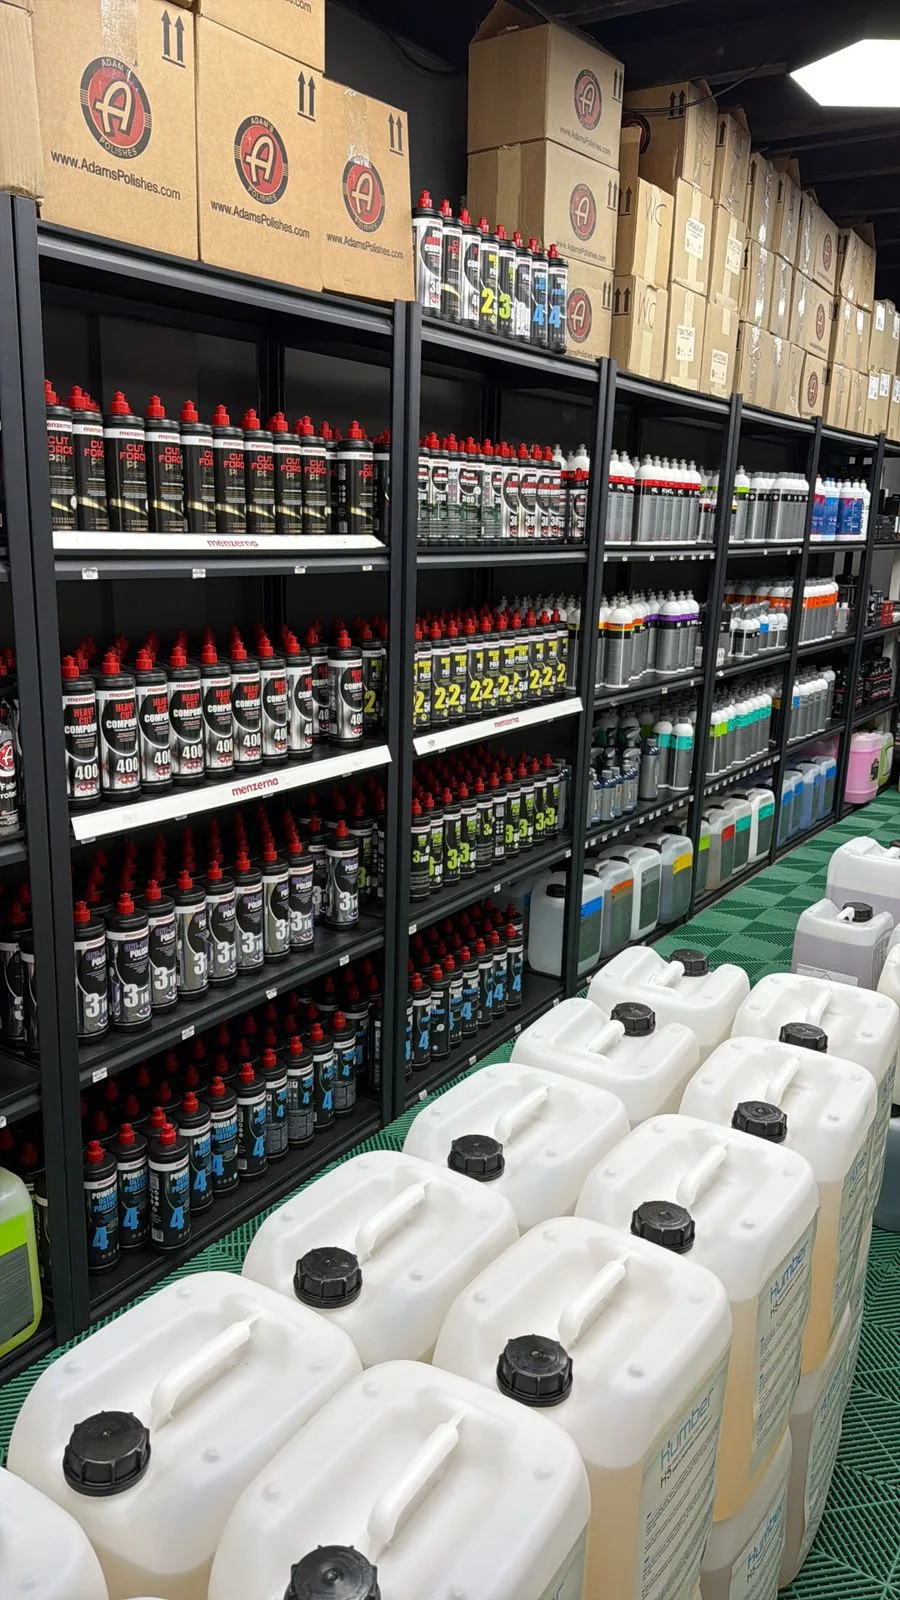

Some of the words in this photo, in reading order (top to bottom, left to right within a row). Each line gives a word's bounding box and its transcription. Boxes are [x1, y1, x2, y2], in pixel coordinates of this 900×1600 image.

[251, 116, 274, 132] ADAM'S
[100, 137, 137, 157] POLISHES
[51, 151, 181, 200] www.AdamsPolishes.com
[248, 185, 277, 203] POLISHES
[210, 200, 310, 239] www.AdamsPolishes.com
[326, 232, 404, 260] www.AdamsPolishes.com
[48, 436, 69, 446] CUT
[48, 444, 73, 455] ORCE
[91, 440, 104, 449] CU
[207, 538, 259, 547] menzerna
[530, 669, 540, 689] 2
[542, 666, 553, 686] 2
[557, 663, 566, 683] 2
[449, 684, 460, 706] 2
[470, 680, 481, 702] 2
[482, 678, 493, 699] 2
[498, 675, 509, 696] 2
[186, 701, 198, 709] CUT
[364, 690, 376, 713] 2
[415, 691, 425, 714] 2
[434, 687, 446, 709] 2
[79, 717, 92, 725] CUT
[120, 712, 133, 720] CUT
[182, 744, 203, 759] 400
[75, 763, 98, 780] 400
[117, 757, 139, 774] 400
[231, 776, 279, 797] menzerna
[535, 812, 544, 831] 3
[545, 807, 555, 825] 3
[505, 824, 514, 843] 3
[519, 819, 528, 837] 3
[413, 850, 421, 863] 3
[447, 849, 458, 869] 3
[460, 843, 470, 863] 3
[339, 892, 350, 910] 3
[275, 919, 286, 940] 3
[290, 911, 302, 931] 3
[217, 941, 230, 964] 3
[242, 932, 254, 954] 3
[194, 952, 205, 975] 3
[154, 967, 168, 990] 3
[513, 975, 521, 992] 4
[123, 983, 138, 1008] 3
[494, 983, 503, 1001] 4
[85, 993, 100, 1018] 3
[462, 1002, 472, 1020] 4
[419, 1030, 429, 1050] 4
[323, 1090, 333, 1111] 4
[253, 1136, 265, 1158] 4
[194, 1169, 207, 1192] 4
[123, 1206, 139, 1230] 4
[170, 1206, 184, 1230] 4
[92, 1226, 108, 1250] 4
